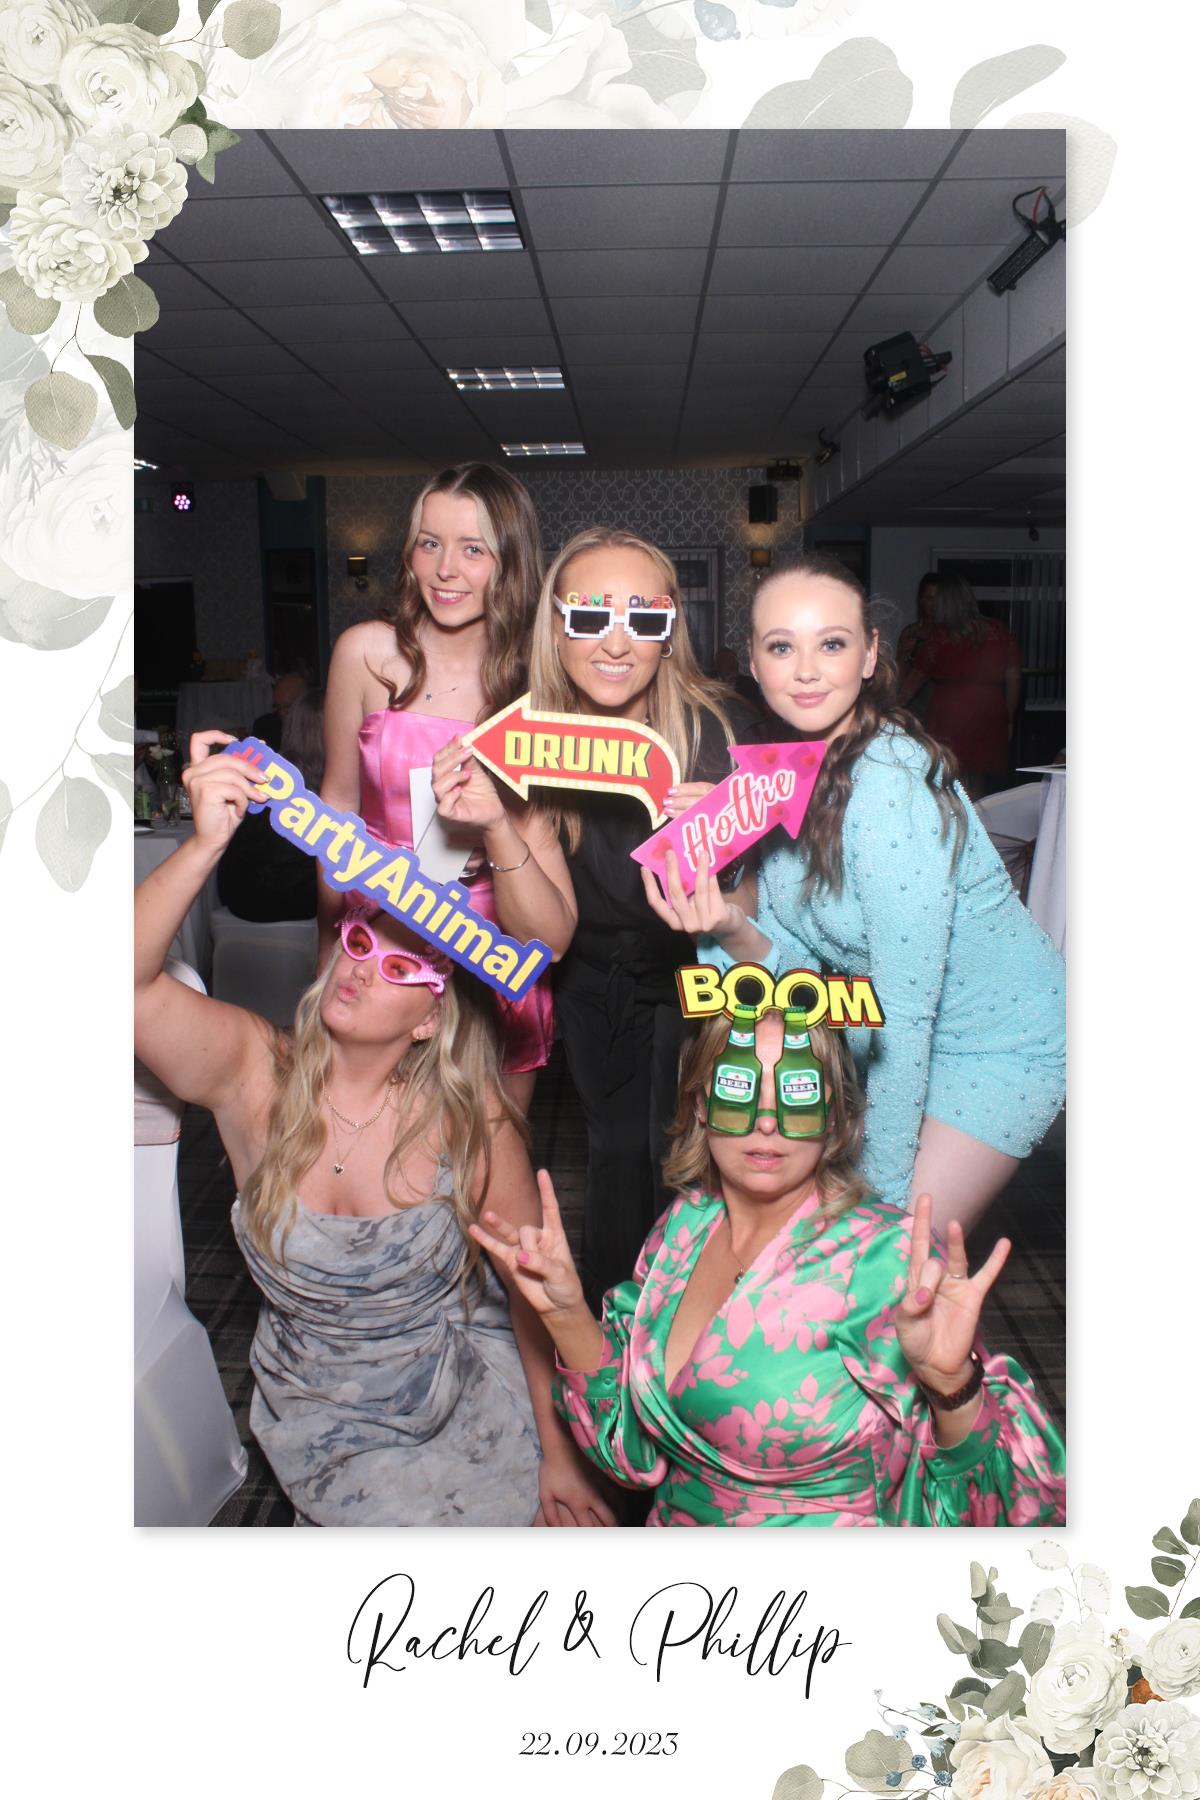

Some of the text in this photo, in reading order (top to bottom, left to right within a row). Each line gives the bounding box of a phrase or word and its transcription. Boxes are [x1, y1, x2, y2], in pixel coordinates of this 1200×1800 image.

[567, 592, 671, 609] GAME OVER
[504, 730, 651, 778] DRUNK
[683, 770, 796, 871] Hottie
[675, 962, 886, 1029] BOOM
[720, 1077, 749, 1089] BEER
[785, 1083, 815, 1092] BEER
